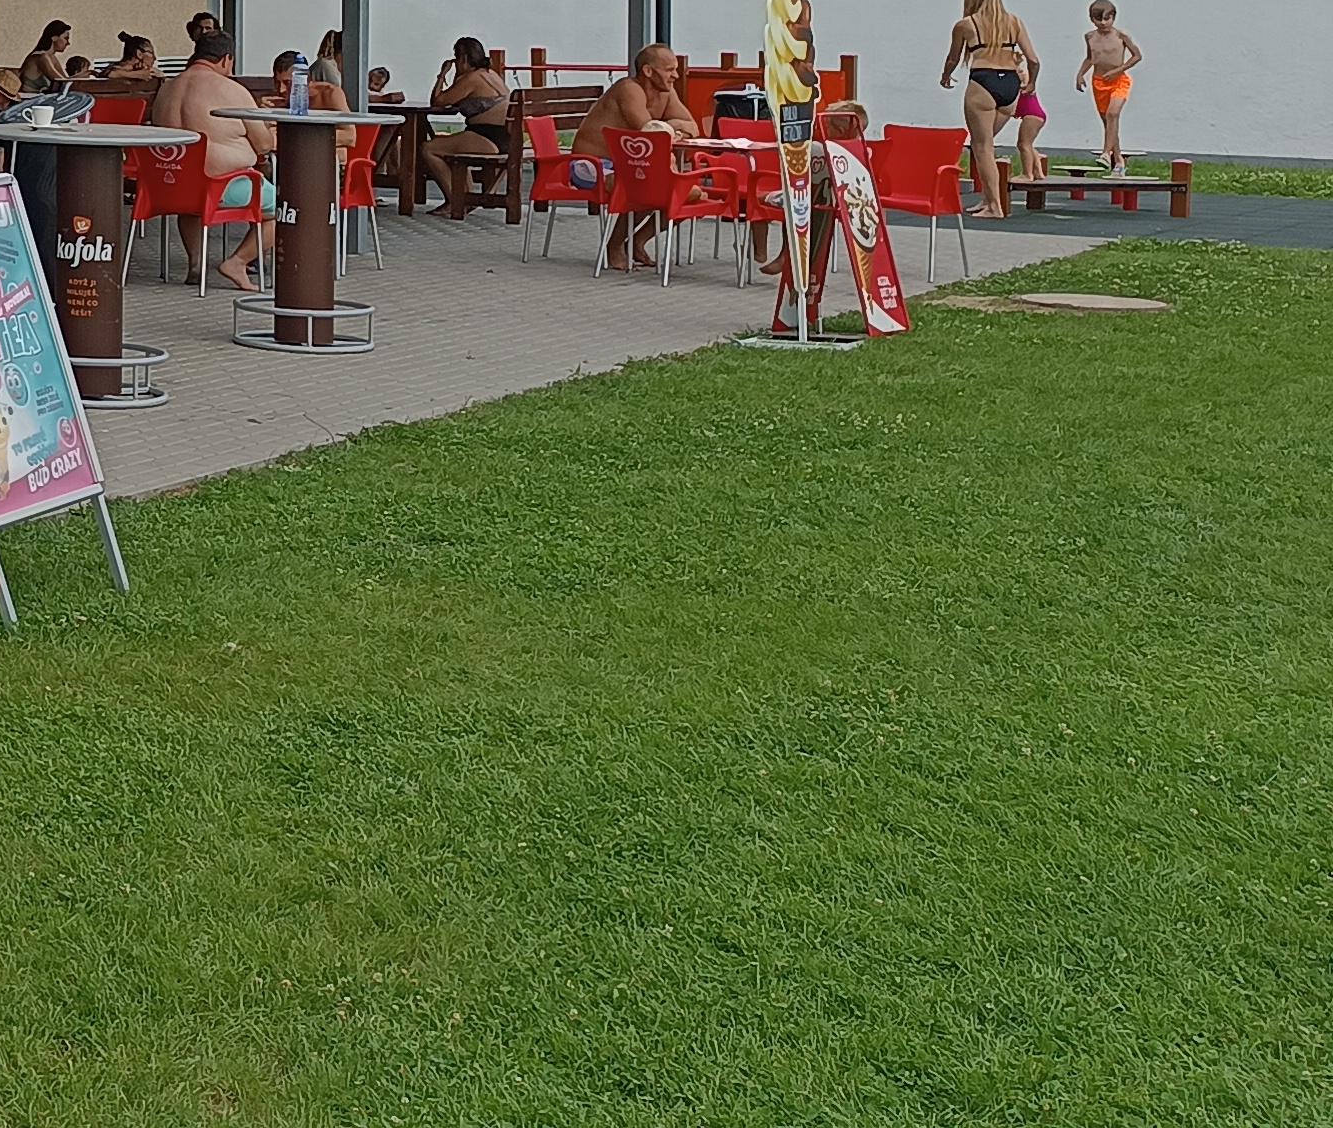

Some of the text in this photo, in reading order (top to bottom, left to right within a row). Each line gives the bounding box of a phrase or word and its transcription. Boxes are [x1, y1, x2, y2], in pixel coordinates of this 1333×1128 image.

[56, 233, 114, 267] kofola
[86, 299, 99, 307] CO
[51, 447, 83, 479] CRAZY
